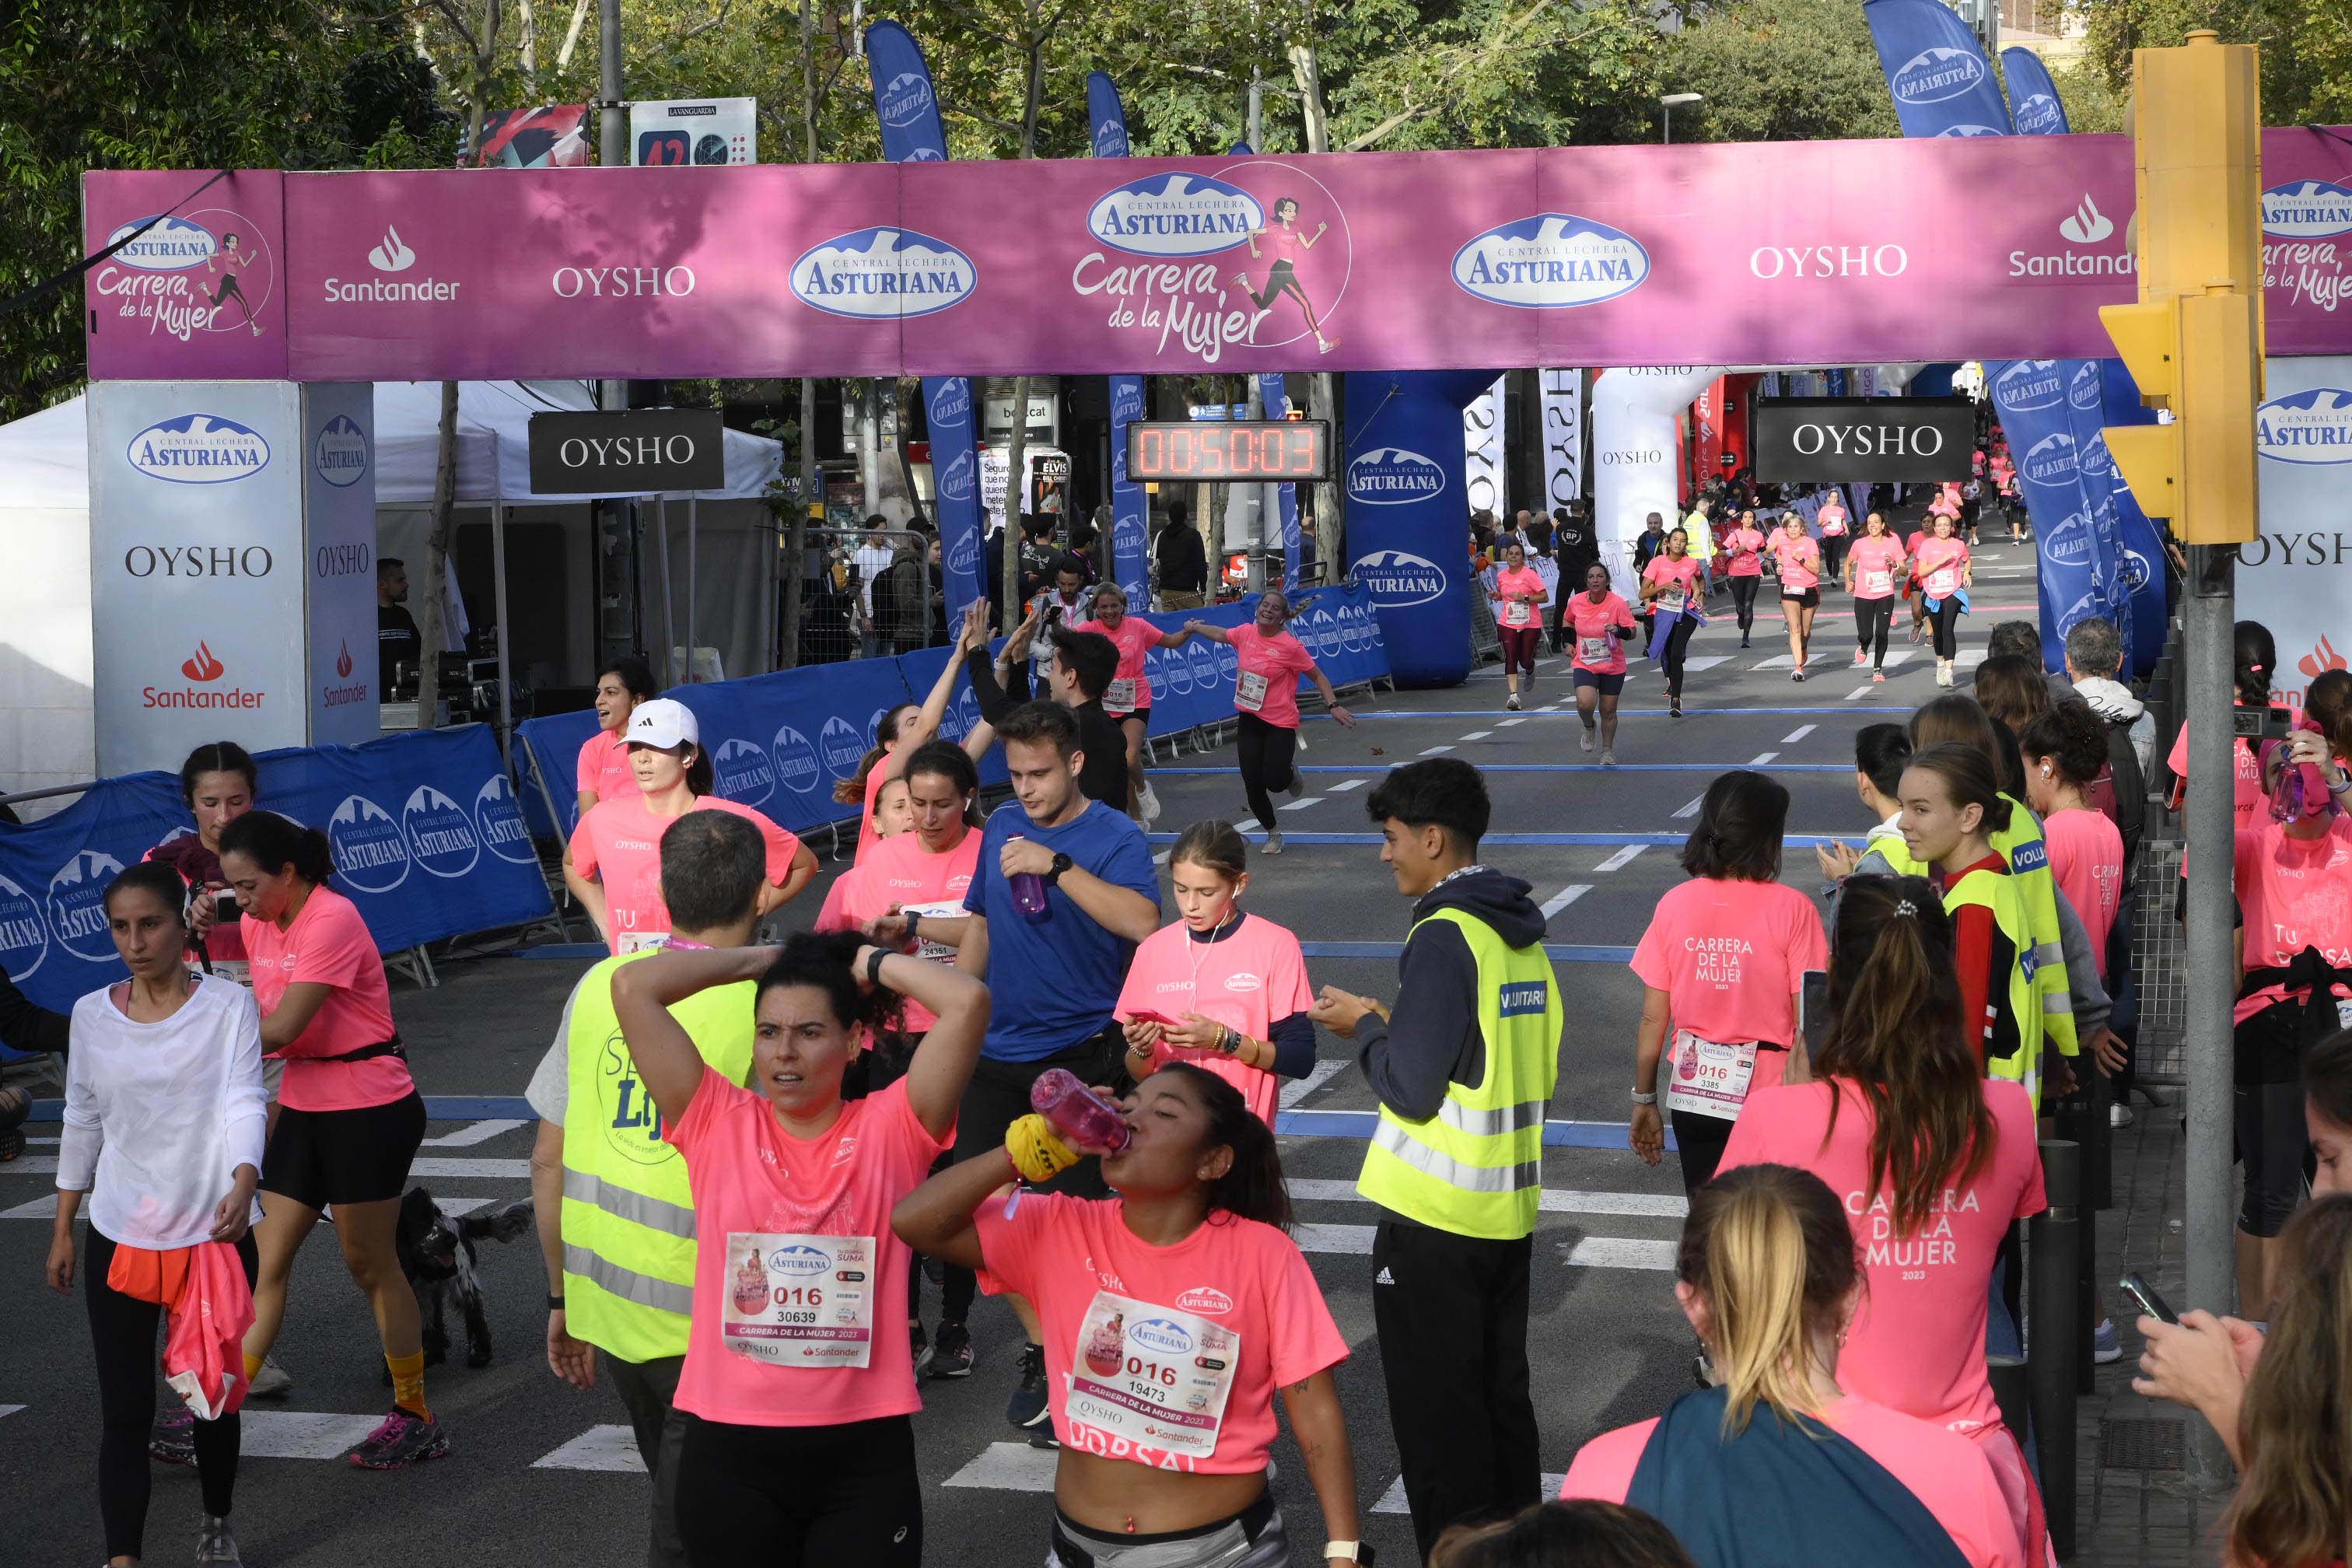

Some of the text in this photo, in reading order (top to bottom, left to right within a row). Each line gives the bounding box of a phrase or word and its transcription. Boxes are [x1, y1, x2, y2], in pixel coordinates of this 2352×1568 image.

[1128, 200, 1245, 211] CENTRAL LECHERA
[1101, 204, 1250, 236] ASTURIANA
[1498, 244, 1627, 257] CENTRAL LECHERA
[2263, 242, 2336, 266] arrera
[833, 257, 957, 268] CENTRAL LECHERA
[1467, 250, 1634, 285] ASTURIANA
[1750, 244, 1908, 279] OYSHO
[2009, 249, 2138, 277] Santand
[96, 266, 188, 296] Carrera
[551, 265, 696, 298] OYSHO
[804, 261, 963, 296] ASTURIANA
[1073, 251, 1218, 296] Carrera
[324, 278, 460, 303] Santander
[2291, 261, 2352, 312] Muje
[119, 292, 224, 342] de la Mujer
[1108, 289, 1273, 363] de la Mujer
[2278, 415, 2331, 423] CENTRAL
[160, 437, 255, 446] CENTRAL LECHERA
[1792, 423, 1943, 457] OYSHO
[138, 439, 261, 467] ASTURIANA
[320, 442, 365, 470] ASTURIANA
[560, 435, 695, 468] OYSHO
[1139, 429, 1314, 474] 00:50:03
[1602, 450, 1662, 465] OYSHO
[1042, 463, 1067, 473] ELVIS
[985, 477, 998, 485] que
[1349, 471, 1438, 492] ASTURIANA
[124, 546, 273, 578] OYSHO
[317, 542, 369, 578] OYSHO
[1367, 579, 1439, 593] TURIANA
[142, 686, 265, 709] Santander
[323, 684, 368, 709] Santander
[778, 752, 817, 779] ASTURIANA
[719, 766, 773, 796] ASTURIANA
[409, 823, 476, 858] ASTURIANA
[615, 839, 653, 851] OYSHO
[335, 835, 408, 872] ASTURIANA
[2014, 847, 2046, 866] VOLU
[889, 878, 922, 888] OYSHO
[615, 908, 636, 929] TU
[2273, 923, 2298, 945] TU
[924, 947, 947, 956] 24351
[1685, 936, 1753, 954] CARRERA
[1699, 953, 1740, 968] DE LA
[1696, 968, 1741, 984] MUJER
[1157, 982, 1194, 994] OYSHO
[1703, 1045, 1733, 1058] ASTURIANA
[1699, 1064, 1728, 1080] 016
[1701, 1080, 1720, 1090] 3385
[772, 1255, 827, 1269] ASTURIANA
[837, 1254, 865, 1262] SUMA
[1866, 1241, 1957, 1267] MUJER
[1902, 1271, 1927, 1280] 2023
[774, 1286, 823, 1306] 016
[1180, 1297, 1230, 1311] ASTURIANA
[777, 1311, 817, 1323] 30639
[739, 1326, 858, 1339] CARRERA DE LA MUJER 2023
[1132, 1325, 1188, 1351] ASTURIANA
[737, 1341, 779, 1356] OYSHO
[815, 1347, 859, 1357] Santander
[1199, 1339, 1227, 1351] SUMA
[1127, 1356, 1178, 1387] 016
[1129, 1381, 1166, 1403] 19473
[1080, 1401, 1123, 1425] OYSHO
[1089, 1384, 1206, 1426] CARRERA DE LA MUJER 2023
[1156, 1427, 1204, 1446] Santander
